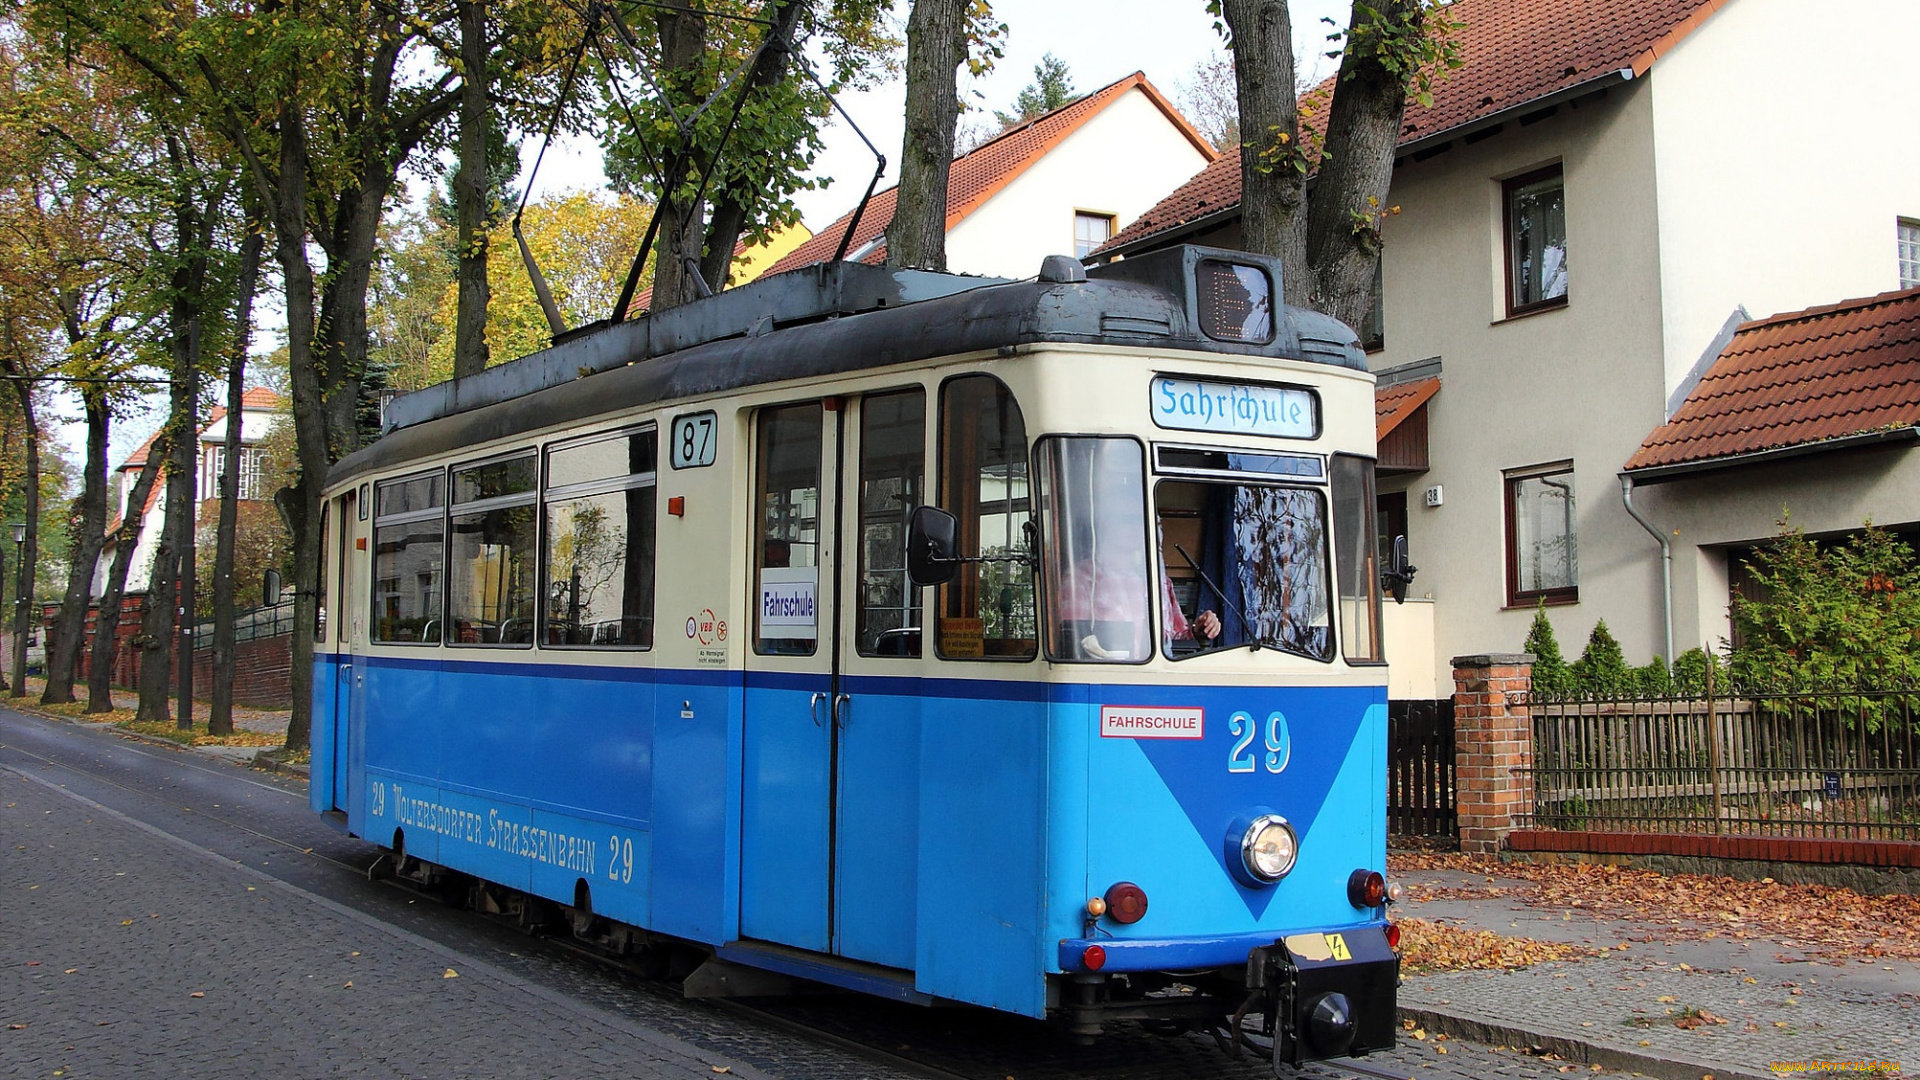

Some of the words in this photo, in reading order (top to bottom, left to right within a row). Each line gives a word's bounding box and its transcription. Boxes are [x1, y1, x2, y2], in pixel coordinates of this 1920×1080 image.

[682, 418, 712, 463] 87
[1427, 488, 1438, 502] 38
[763, 590, 814, 617] Fahrschule
[700, 621, 714, 632] VBB
[1108, 714, 1198, 730] FAHRSCHULE
[1227, 710, 1292, 775] 29
[371, 781, 385, 817] 29
[486, 808, 596, 875] STRASSENBAHN
[607, 834, 634, 884] 29
